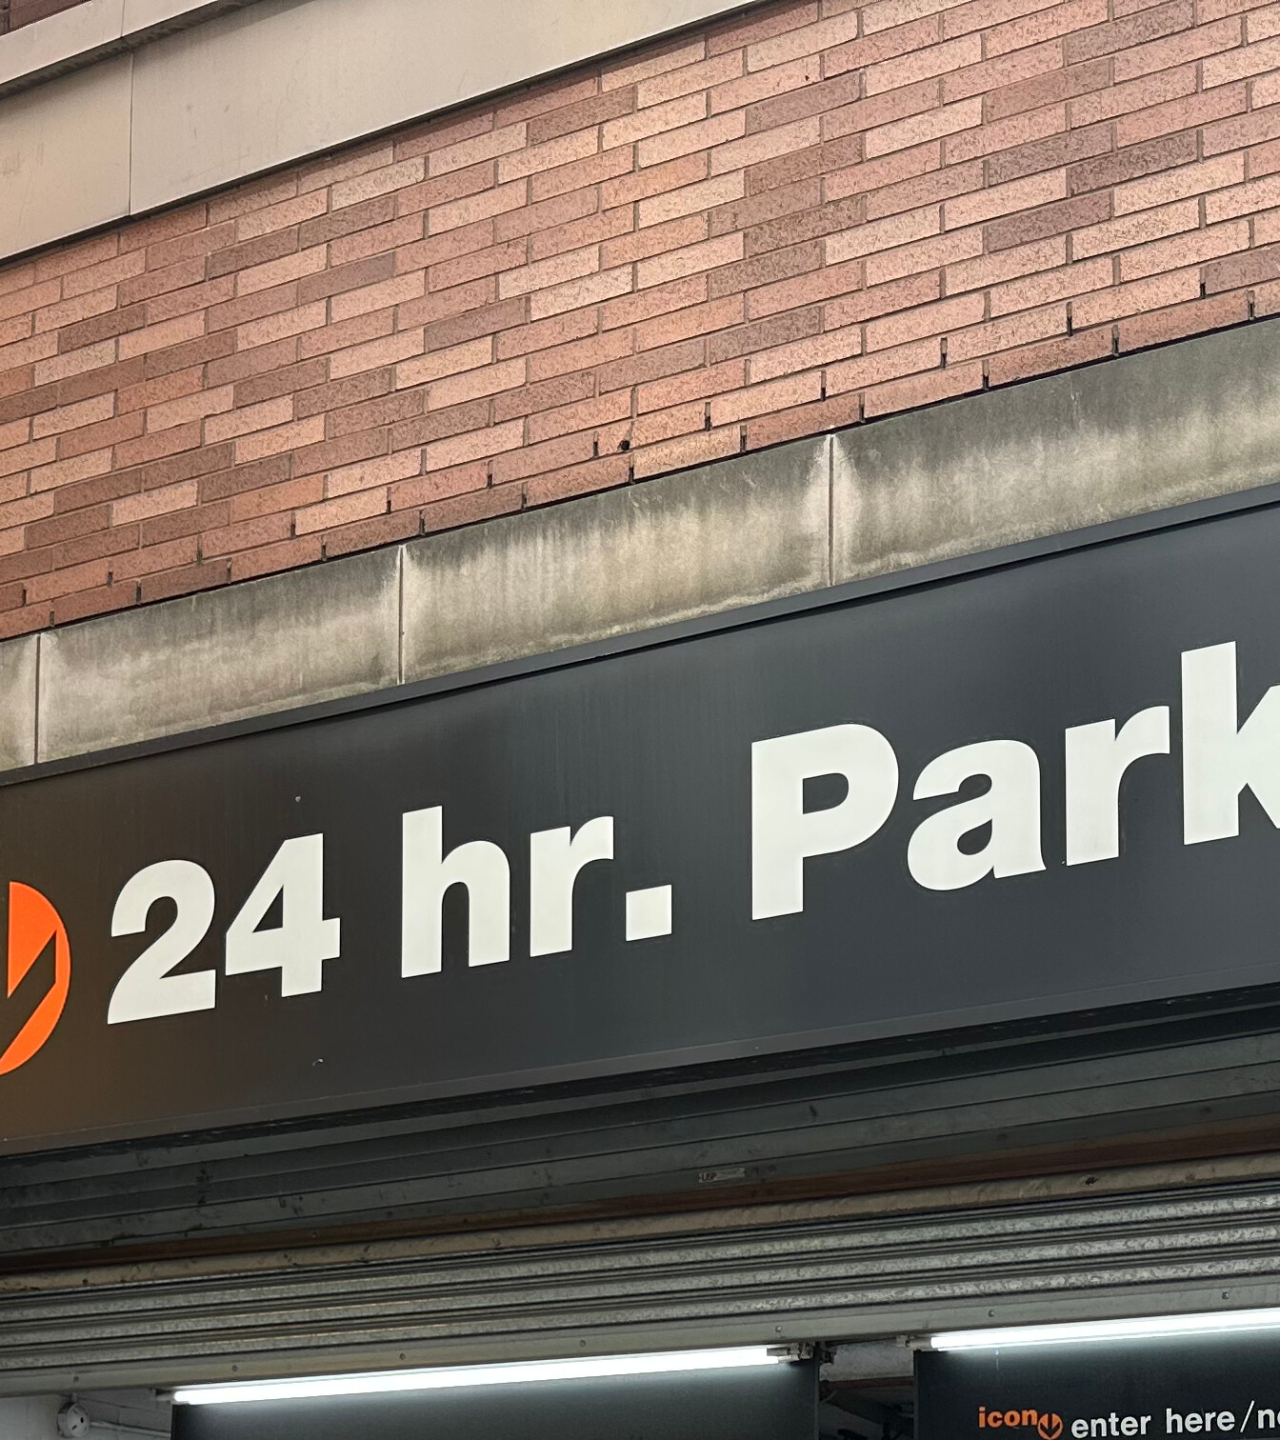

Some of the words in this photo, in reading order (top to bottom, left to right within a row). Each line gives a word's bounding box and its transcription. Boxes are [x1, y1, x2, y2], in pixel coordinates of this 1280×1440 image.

[107, 832, 341, 1025] 24
[402, 805, 674, 980] hr.
[979, 1406, 1037, 1428] icon
[1071, 1412, 1151, 1438] enter
